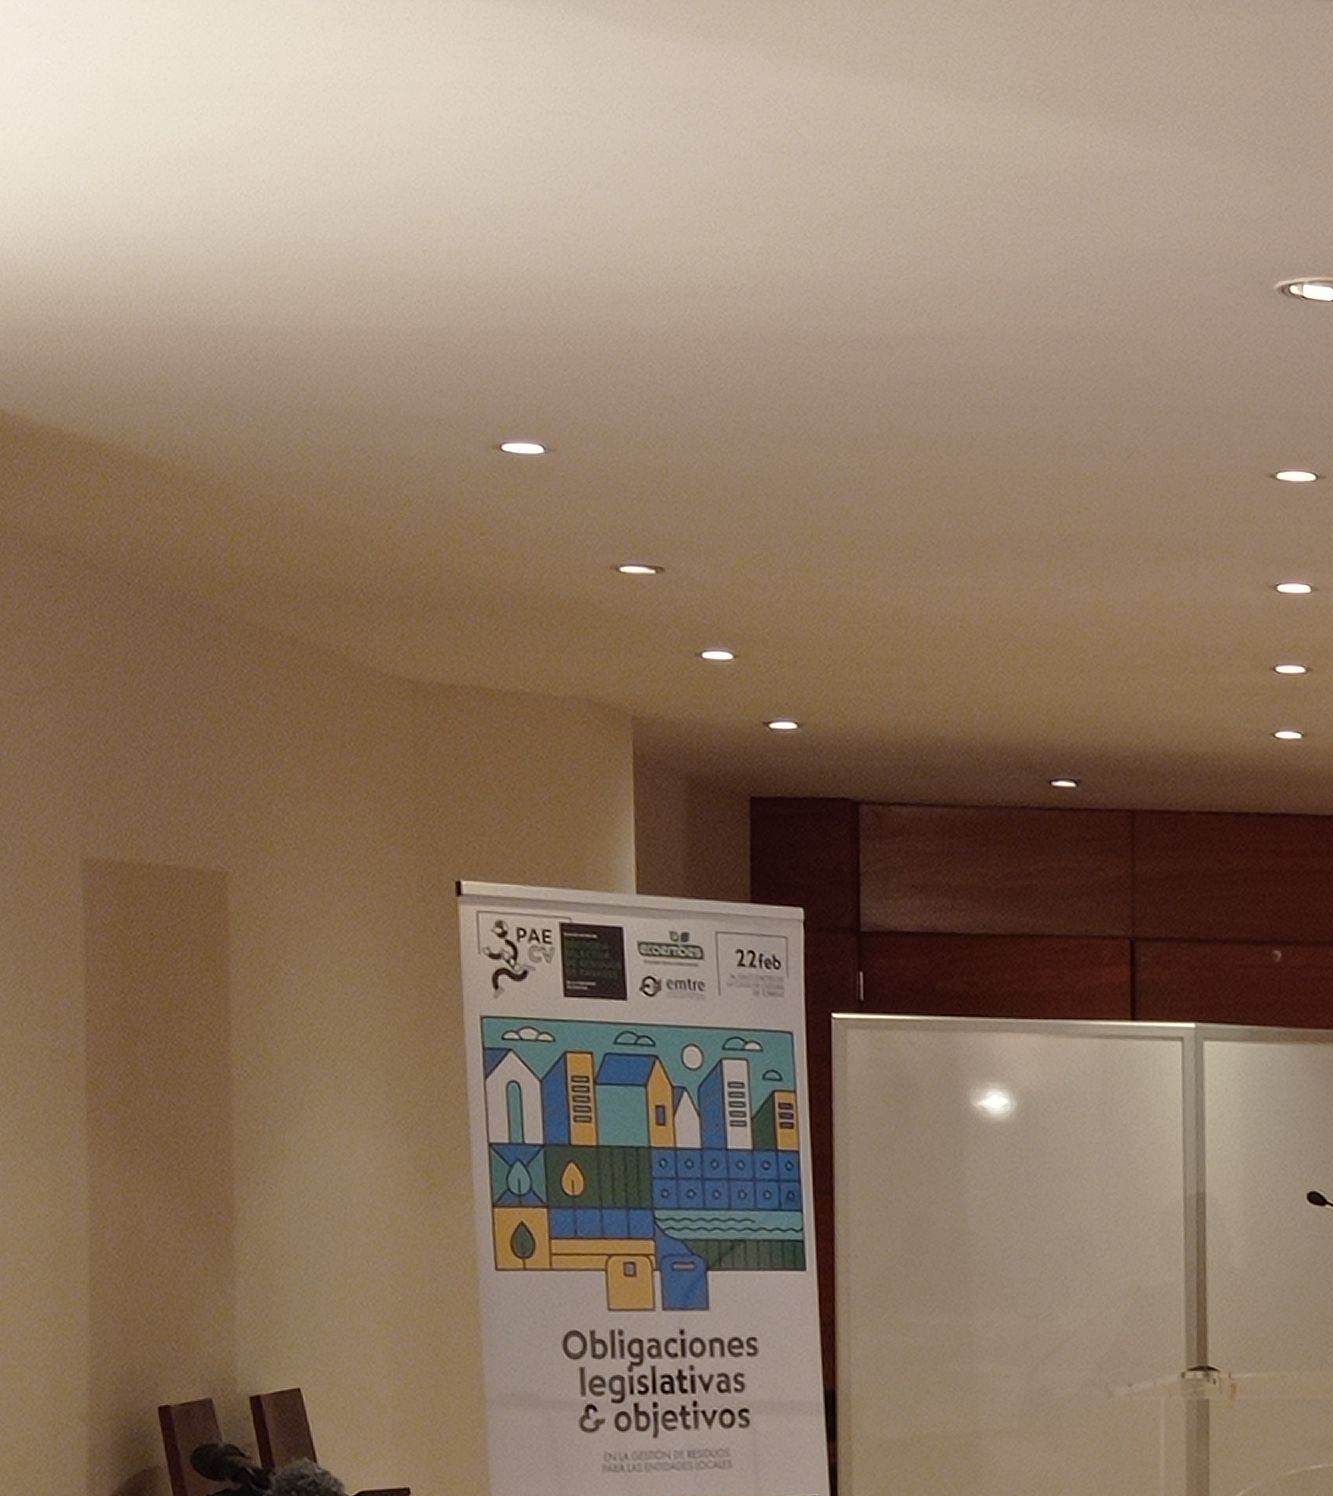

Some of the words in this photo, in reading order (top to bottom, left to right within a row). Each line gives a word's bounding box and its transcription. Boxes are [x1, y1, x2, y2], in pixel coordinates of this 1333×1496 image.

[516, 927, 553, 944] PAE
[736, 948, 782, 970] 22feb
[666, 977, 706, 993] emtre
[562, 1329, 759, 1367] Obligaciones
[579, 1365, 746, 1404] legislativas
[579, 1404, 605, 1433] &
[614, 1401, 751, 1438] objetivos
